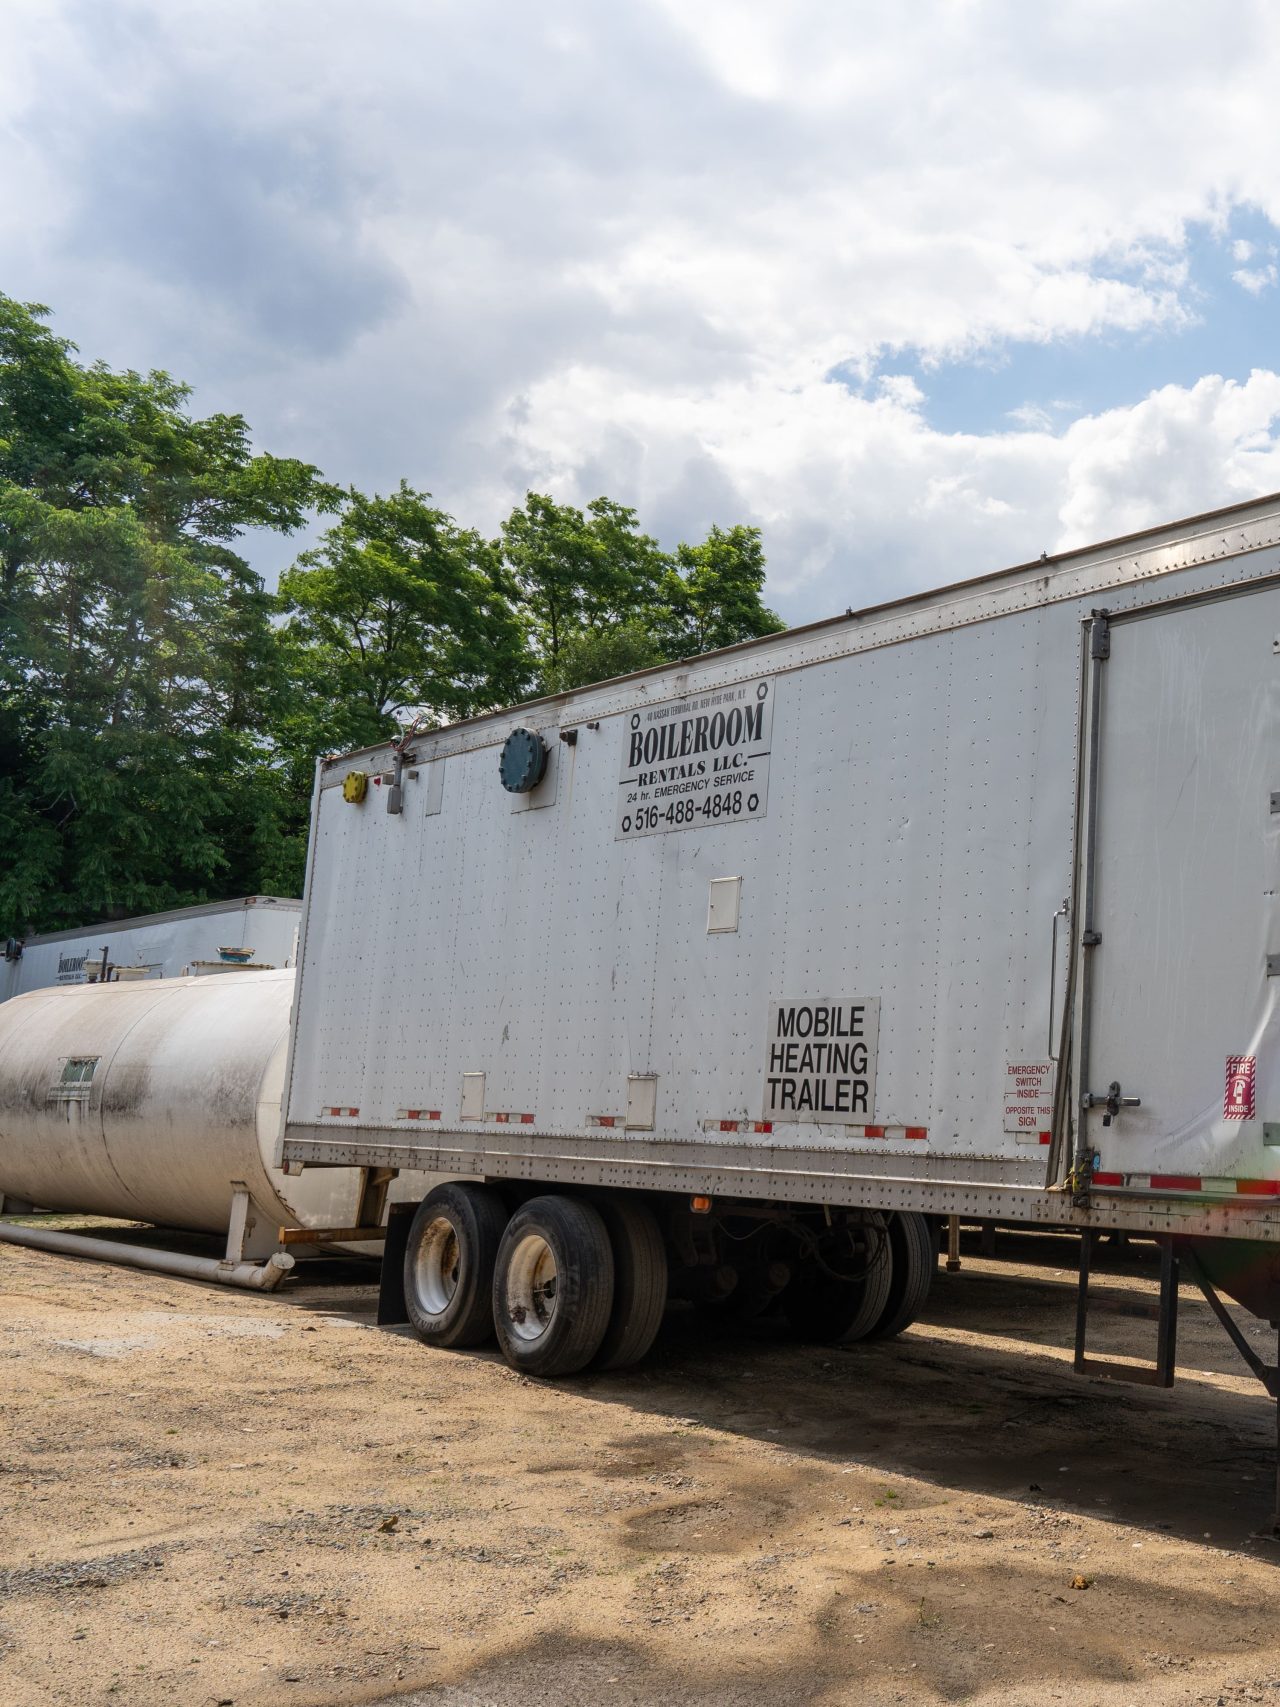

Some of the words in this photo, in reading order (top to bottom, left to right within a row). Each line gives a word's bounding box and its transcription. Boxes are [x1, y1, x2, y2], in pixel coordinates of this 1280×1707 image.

[628, 701, 765, 768] BOILEROOM
[638, 760, 706, 787] RENTALS
[713, 752, 748, 772] LLC.
[627, 793, 638, 803] 24
[641, 790, 651, 801] hr.
[654, 777, 710, 799] EMERGENCY
[713, 769, 755, 788] SERVICE
[635, 790, 742, 831] 516-488-4848
[777, 1006, 865, 1038] MOBILE
[770, 1042, 868, 1075] HEATING
[1230, 1062, 1251, 1074] FIRE
[1007, 1065, 1051, 1075] EMERGENCY
[1015, 1077, 1042, 1087] SWITCH
[767, 1077, 869, 1113] TRAILER
[1016, 1089, 1039, 1098] INSIDE
[1005, 1106, 1034, 1115] OPPOSITE
[1037, 1106, 1051, 1115] THIS
[1228, 1104, 1249, 1113] INSIDE
[1018, 1116, 1037, 1127] SIGN
